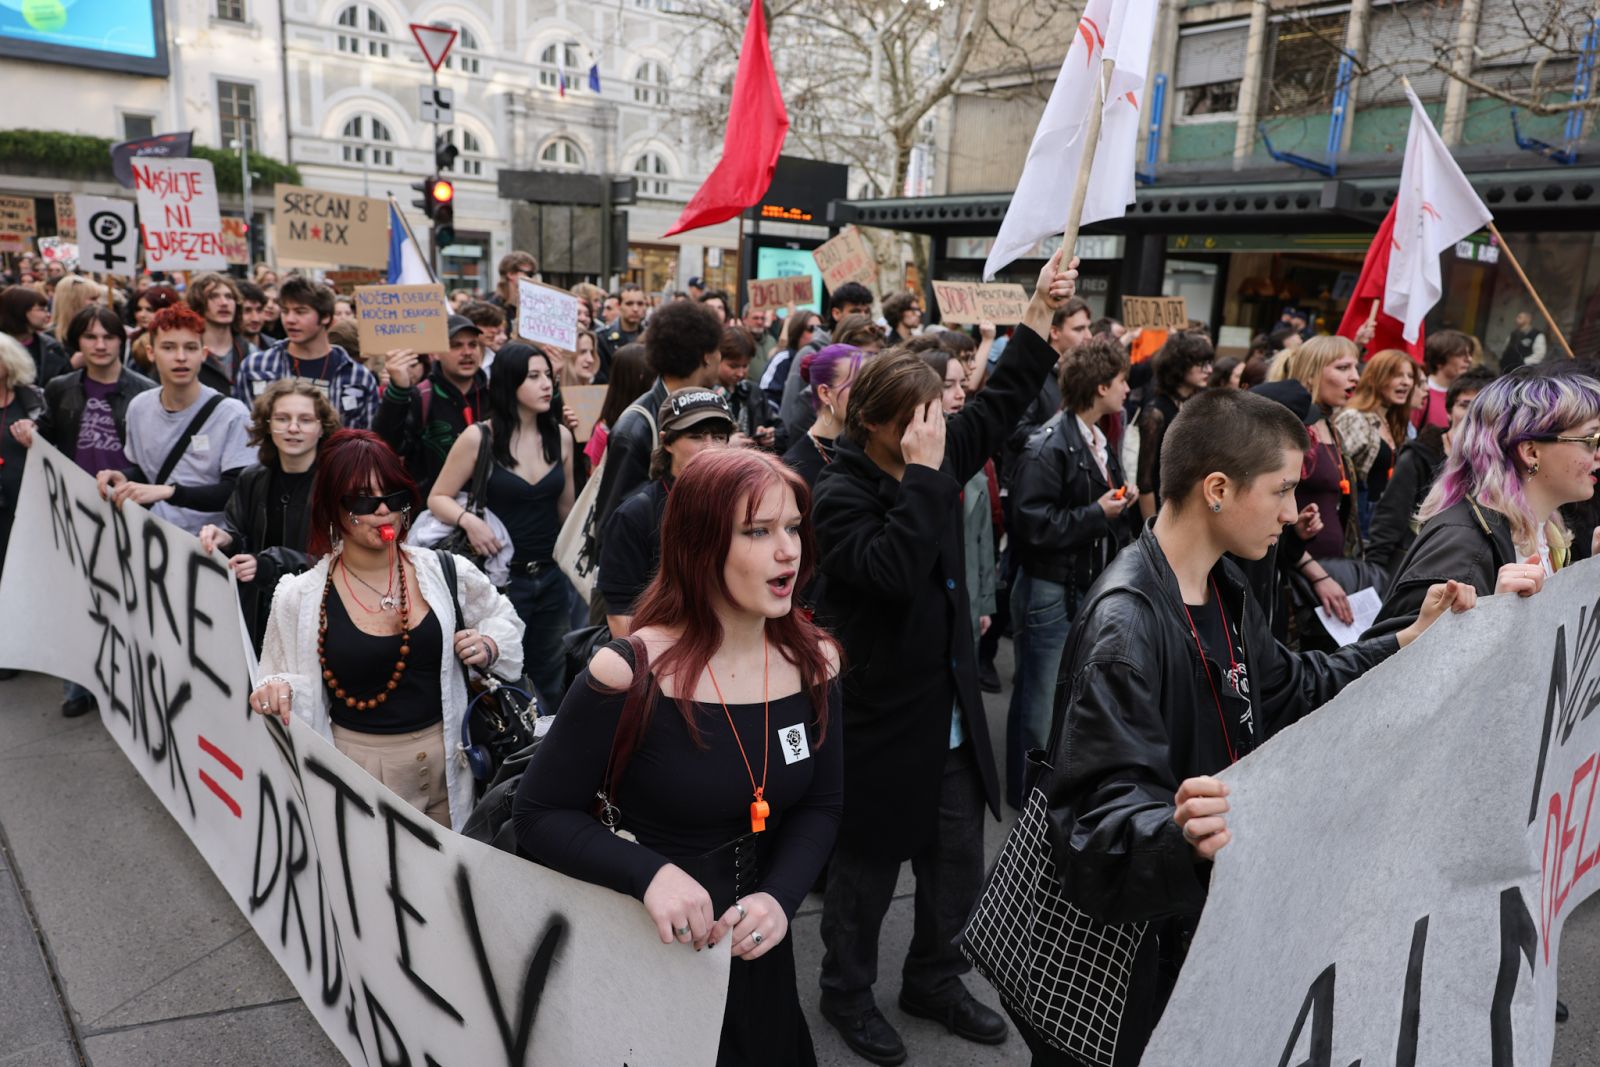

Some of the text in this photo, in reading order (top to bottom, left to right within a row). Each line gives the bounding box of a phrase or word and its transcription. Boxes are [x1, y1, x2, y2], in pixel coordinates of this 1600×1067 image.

[131, 164, 203, 202] NASILJE
[165, 205, 191, 228] NI
[284, 192, 368, 221] SREČAN 8
[141, 223, 225, 262] LJUBEZEN
[358, 291, 400, 305] NOČEM
[362, 307, 398, 320] HOČEM
